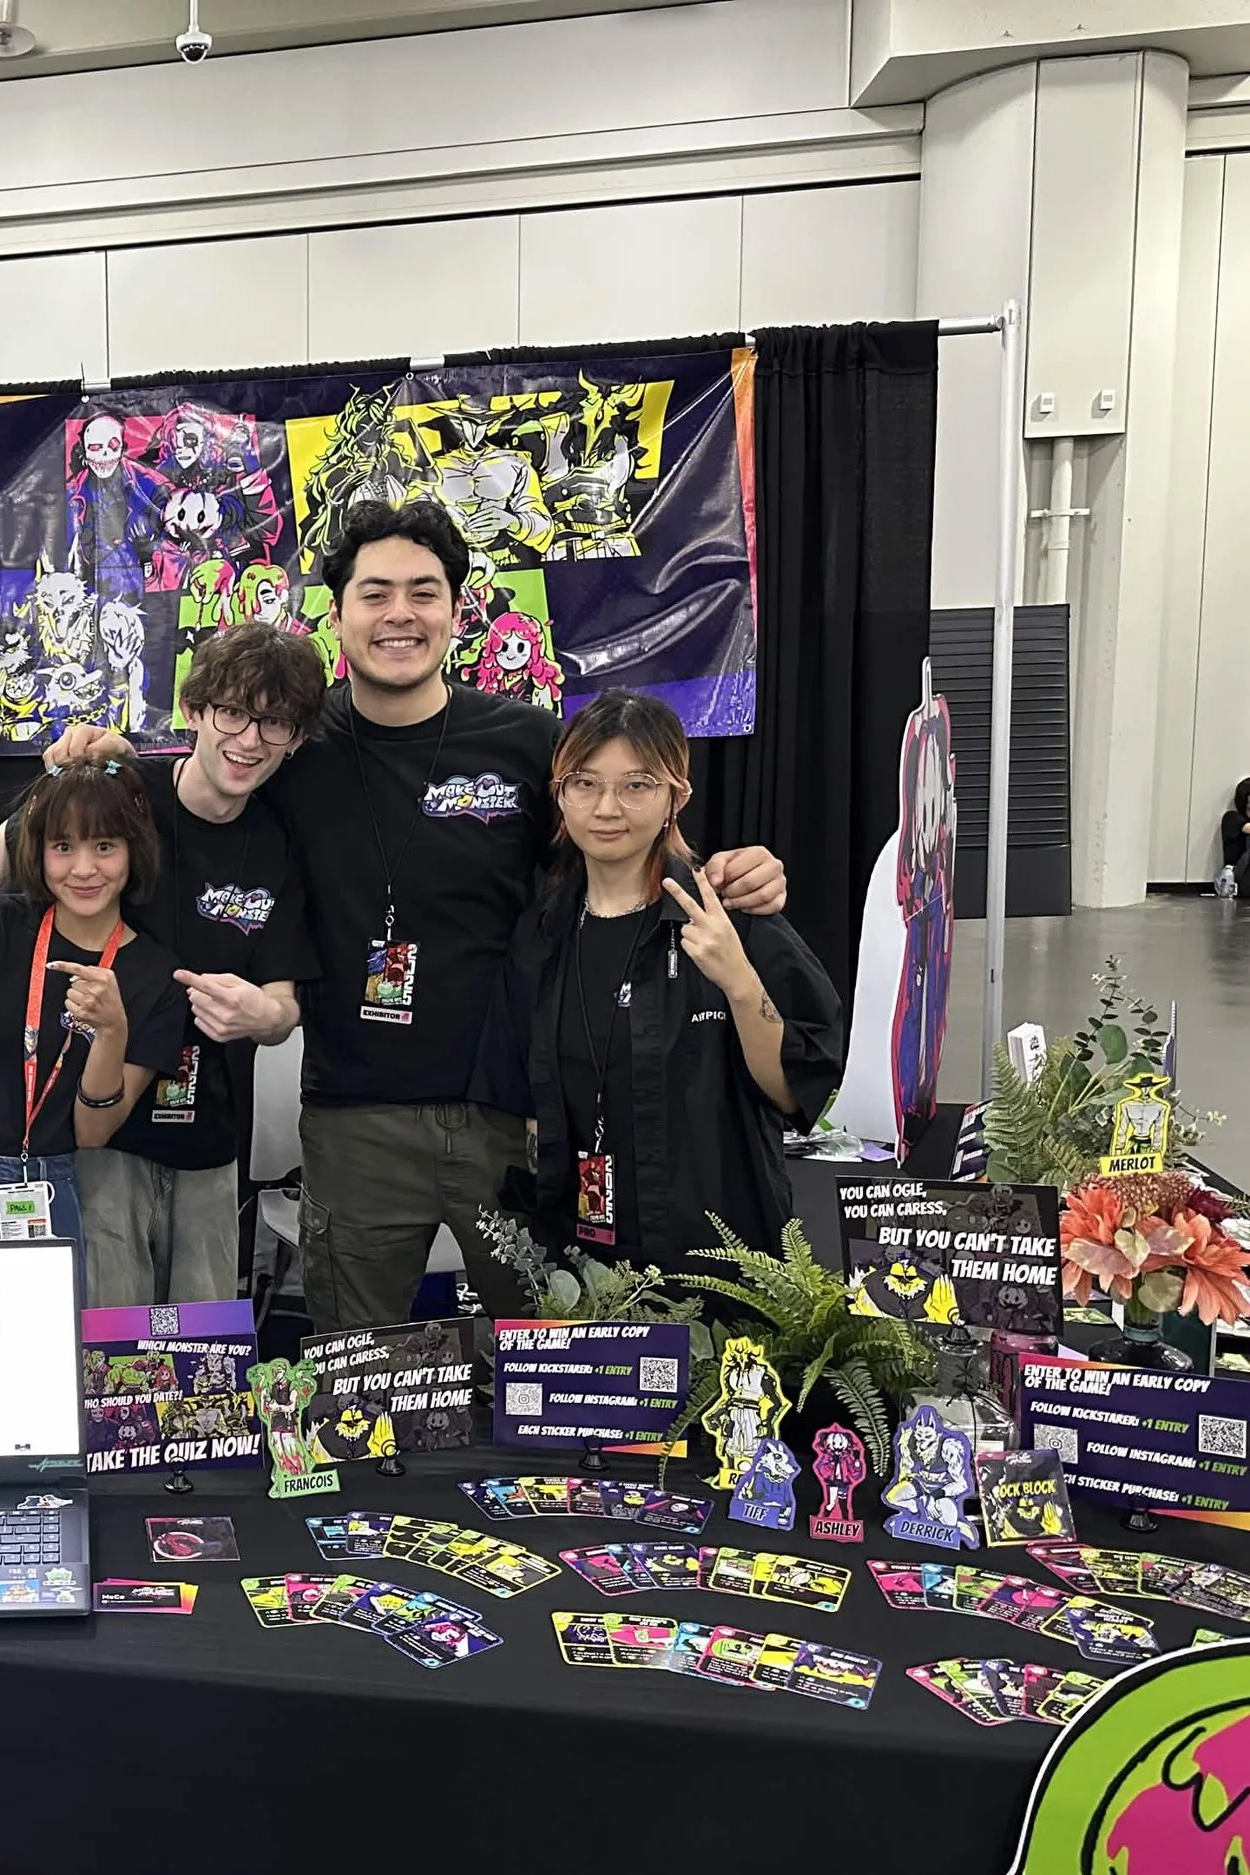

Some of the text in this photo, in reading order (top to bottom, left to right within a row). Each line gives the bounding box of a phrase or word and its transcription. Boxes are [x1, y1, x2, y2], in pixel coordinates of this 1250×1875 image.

[1108, 1155, 1157, 1173] MERLOT
[605, 1154, 613, 1225] 2025
[839, 1182, 927, 1201] YOU CAN OGLE,
[844, 1204, 867, 1219] YOU
[870, 1203, 895, 1218] CAN
[878, 1226, 1057, 1257] BUT YOU CAN'T TAKE
[951, 1259, 1058, 1286] THEM HOME
[499, 1326, 650, 1341] ENTER TO WIN AN EARLY COPY
[137, 1340, 251, 1356] WHICH MONSTER ARE YOU?
[304, 1331, 375, 1359] YOU CAN OGLE,
[499, 1338, 572, 1351] OF THE GAME!
[313, 1362, 326, 1376] OU
[327, 1357, 348, 1372] CAN
[503, 1362, 537, 1373] FOLLOW
[605, 1365, 633, 1376] ENTRY
[333, 1364, 473, 1395] BUT YOU CAN'T TAKE
[1024, 1364, 1211, 1394] ENTER TO WIN AN EARLY COPY
[1025, 1377, 1113, 1396] OF THE GAME!
[100, 1396, 133, 1408] SHOULD
[134, 1393, 152, 1405] YOU
[390, 1389, 473, 1413] THEM HOME
[549, 1393, 582, 1404] FOLLOW
[650, 1398, 678, 1409] ENTRY
[1030, 1401, 1071, 1417] FOLLOW
[1154, 1420, 1190, 1434] ENTRY
[517, 1425, 540, 1436] EACH
[541, 1426, 576, 1437] STICKER
[635, 1431, 663, 1442] ENTRY
[129, 1444, 161, 1468] THE
[164, 1440, 207, 1464] QUIZ
[210, 1434, 262, 1457] NOW!
[1086, 1442, 1129, 1459] FOLLOW
[1211, 1463, 1248, 1477] ENTRY
[284, 1474, 333, 1493] FRANCOIS
[1023, 1479, 1057, 1495] BLOCK
[1063, 1474, 1076, 1485] CH
[1077, 1476, 1120, 1493] STICKER
[1194, 1495, 1229, 1510] ENTRY
[743, 1503, 769, 1520] TIFF
[815, 1520, 860, 1537] ASHLEY
[901, 1520, 955, 1542] DERRICK
